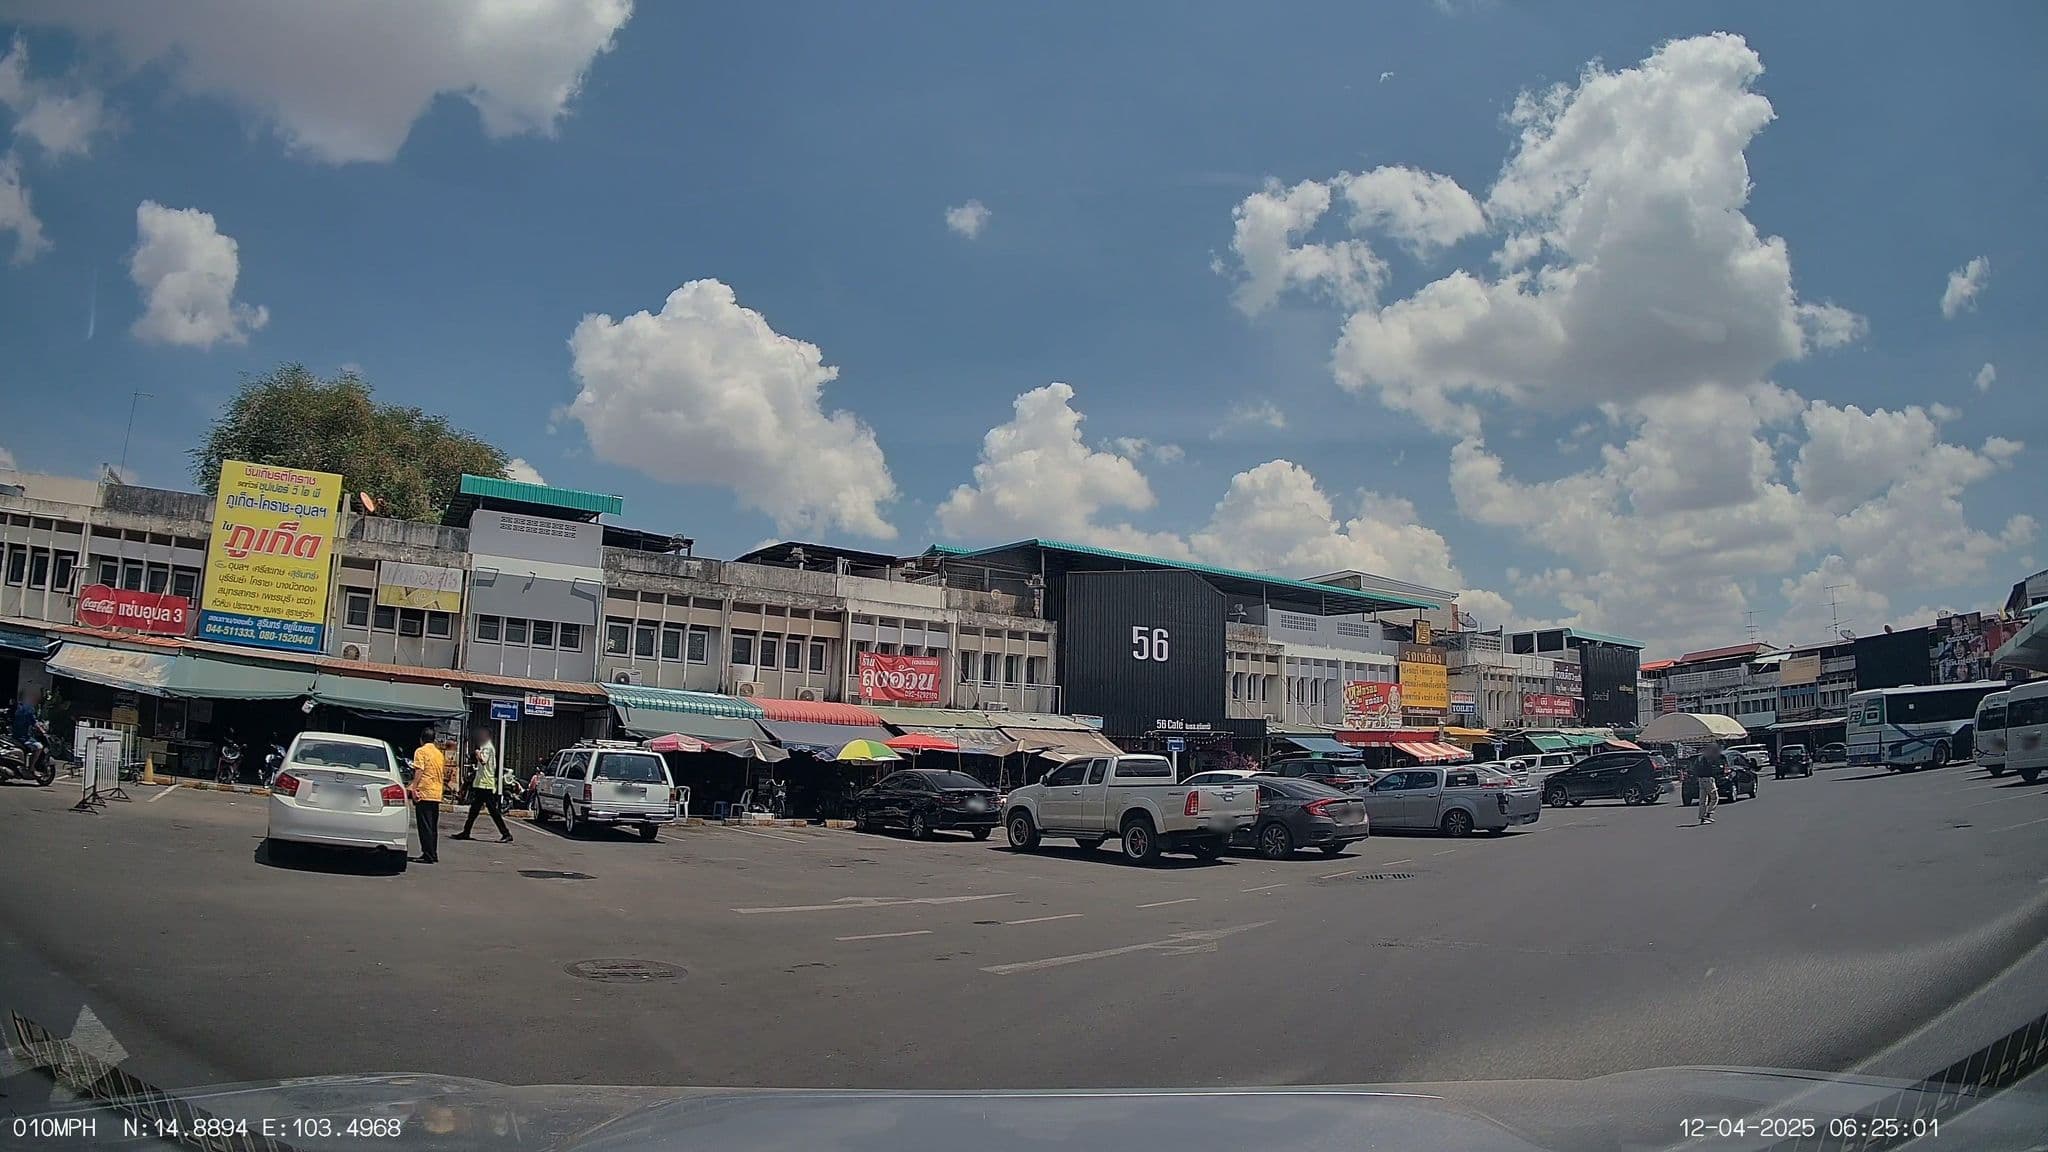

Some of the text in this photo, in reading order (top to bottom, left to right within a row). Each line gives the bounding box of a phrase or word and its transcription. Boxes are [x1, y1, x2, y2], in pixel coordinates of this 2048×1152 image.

[222, 521, 233, 531] ไป
[224, 521, 324, 559] ภูเก็ต
[172, 608, 182, 623] 3
[1132, 626, 1169, 662] 56
[1452, 705, 1474, 713] TOILET
[1156, 719, 1167, 729] 56
[1167, 718, 1184, 729] Café
